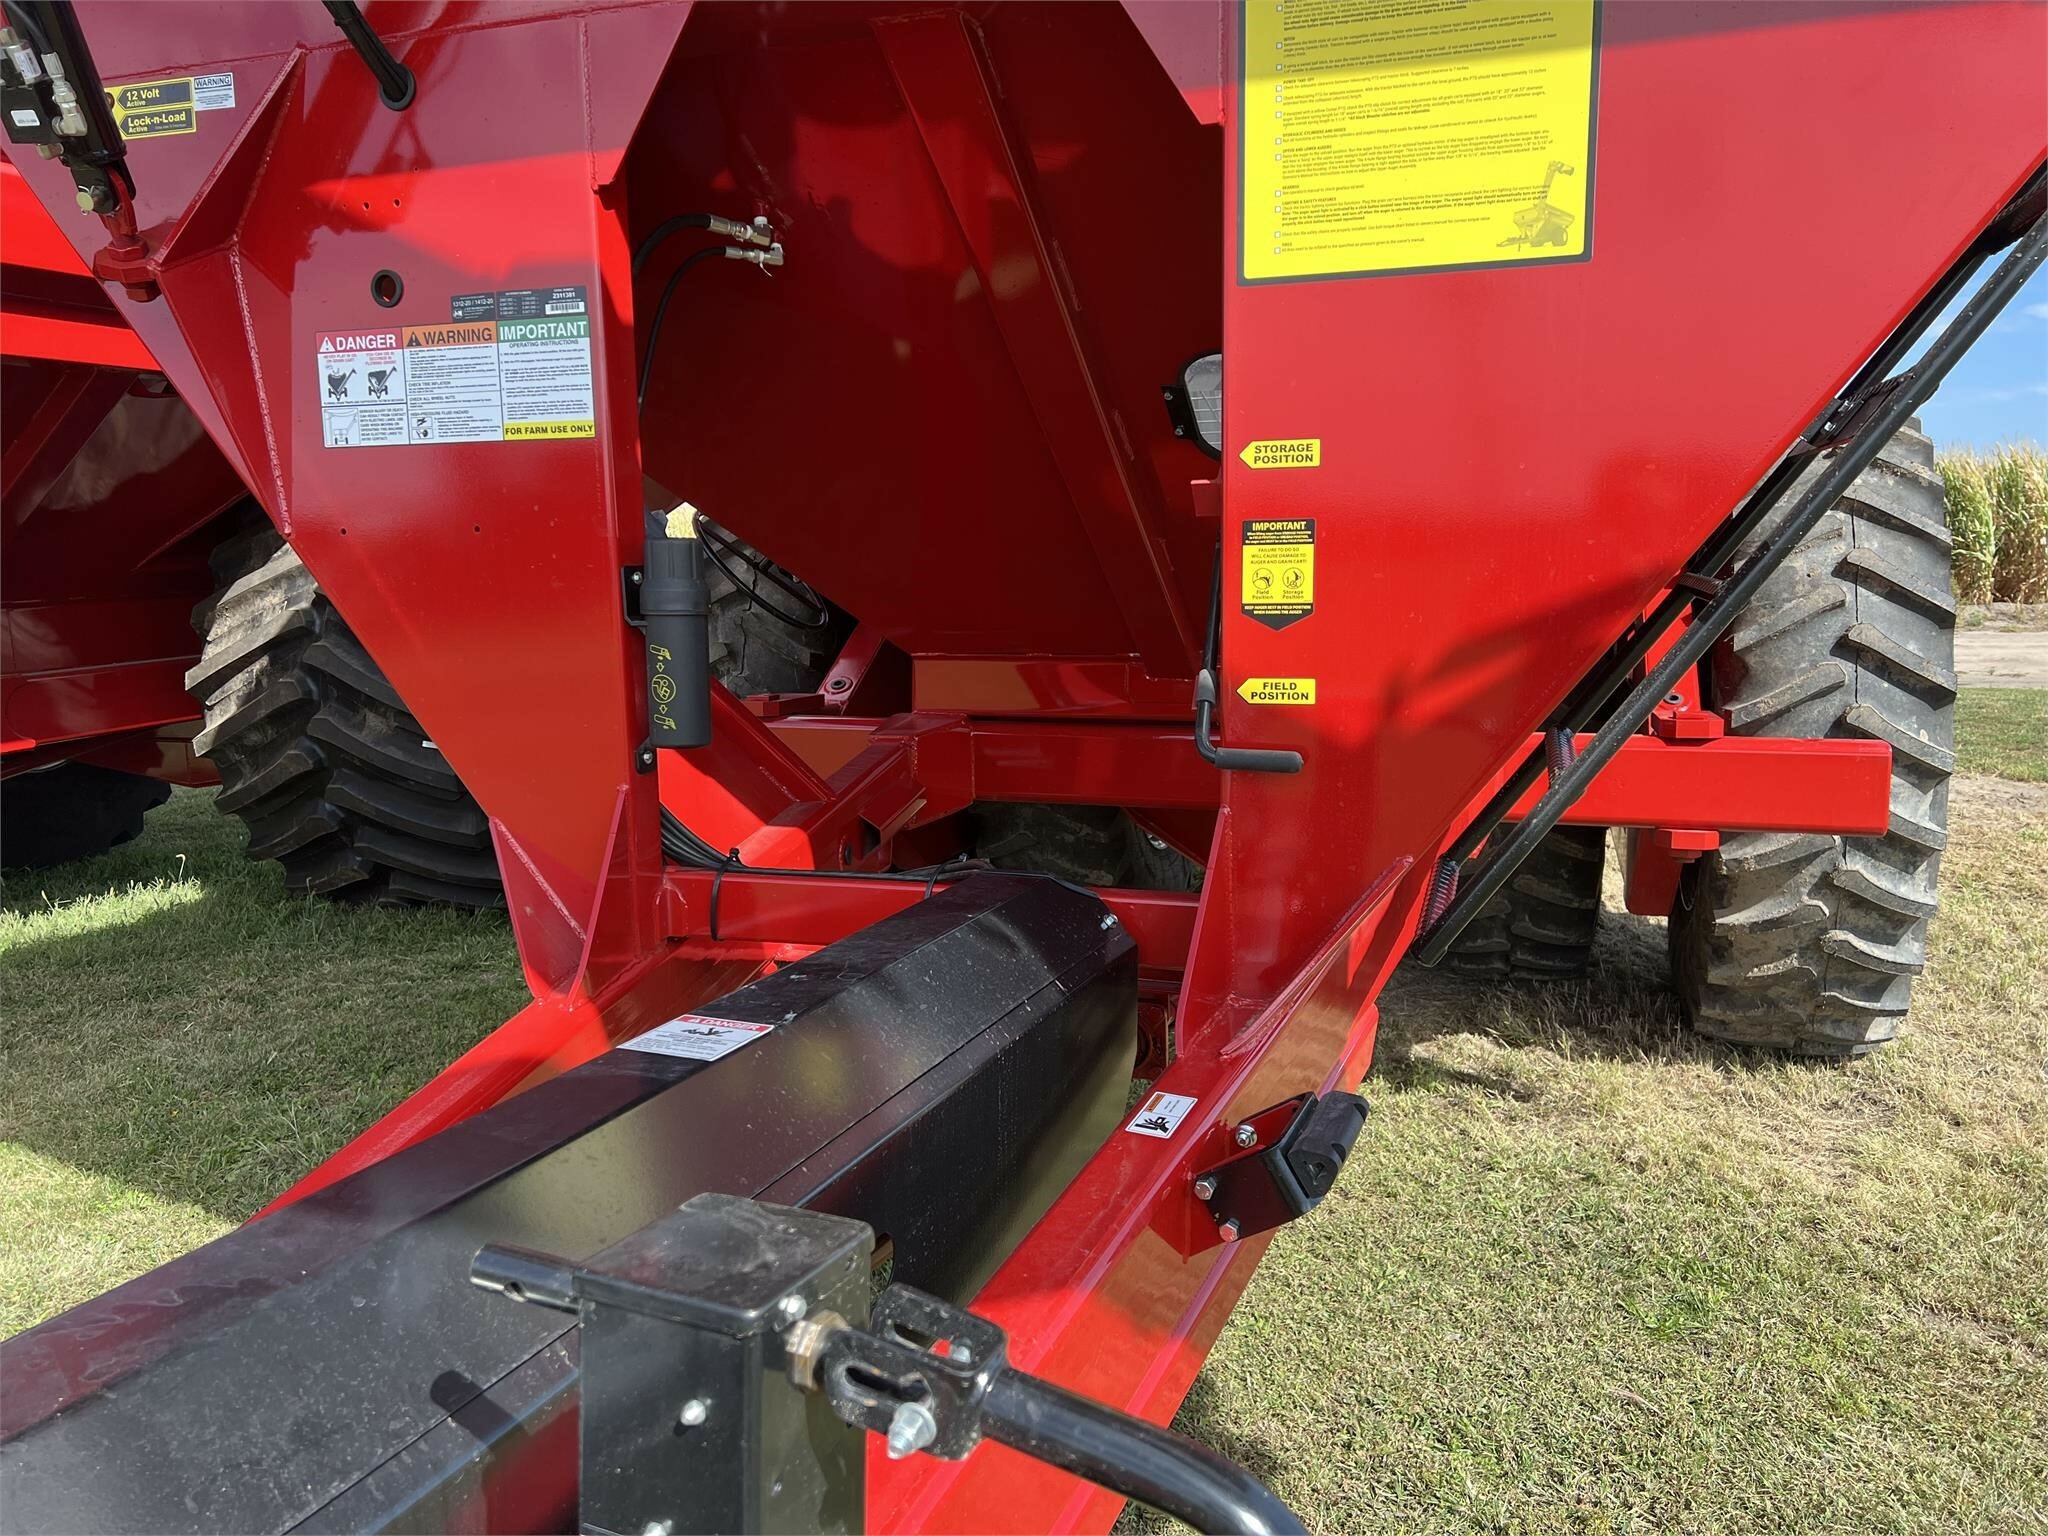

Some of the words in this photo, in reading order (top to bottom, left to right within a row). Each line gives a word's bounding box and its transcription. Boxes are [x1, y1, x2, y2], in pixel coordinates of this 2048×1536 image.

[196, 77, 230, 87] WARNING
[126, 91, 138, 100] 12
[140, 88, 160, 99] Volt
[128, 112, 186, 126] Lock-n-Load
[500, 321, 586, 340] IMPORTANT
[423, 328, 492, 345] WARNING
[336, 334, 396, 350] DANGER
[525, 426, 548, 434] FARM
[570, 424, 593, 432] ONLY
[1254, 444, 1314, 454] STORAGE
[1254, 454, 1314, 464] POSITION
[1253, 522, 1306, 530] IMPORTANT
[1263, 682, 1297, 690] FIELD
[1251, 691, 1309, 700] POSITION
[702, 1019, 760, 1030] DANGER
